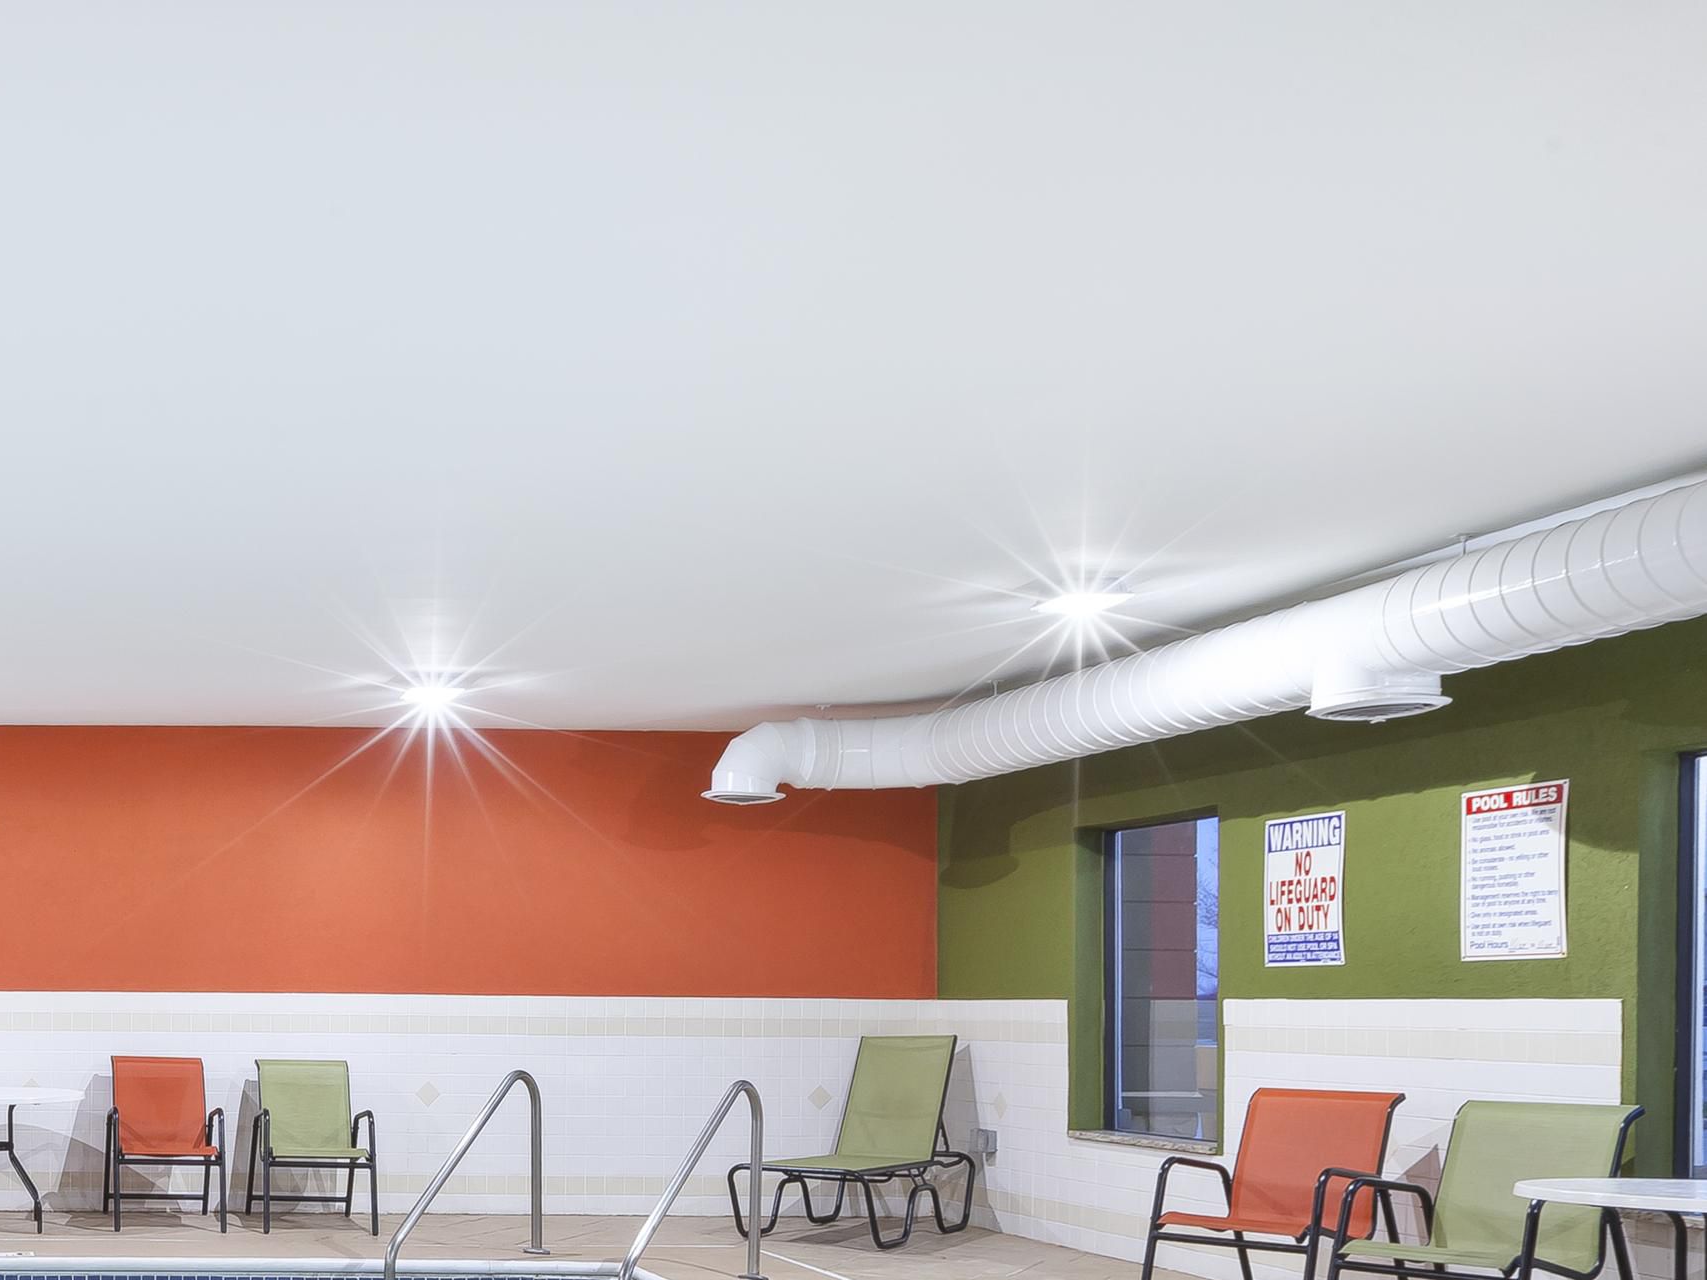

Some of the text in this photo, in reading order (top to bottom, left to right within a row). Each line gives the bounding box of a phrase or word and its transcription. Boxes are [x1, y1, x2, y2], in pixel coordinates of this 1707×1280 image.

[1471, 787, 1558, 812] POOL RULES
[1269, 817, 1340, 852] WARNING
[1294, 851, 1312, 877] NO
[1270, 876, 1337, 906] LIFEGUARD
[1275, 904, 1330, 932] ON DUTY
